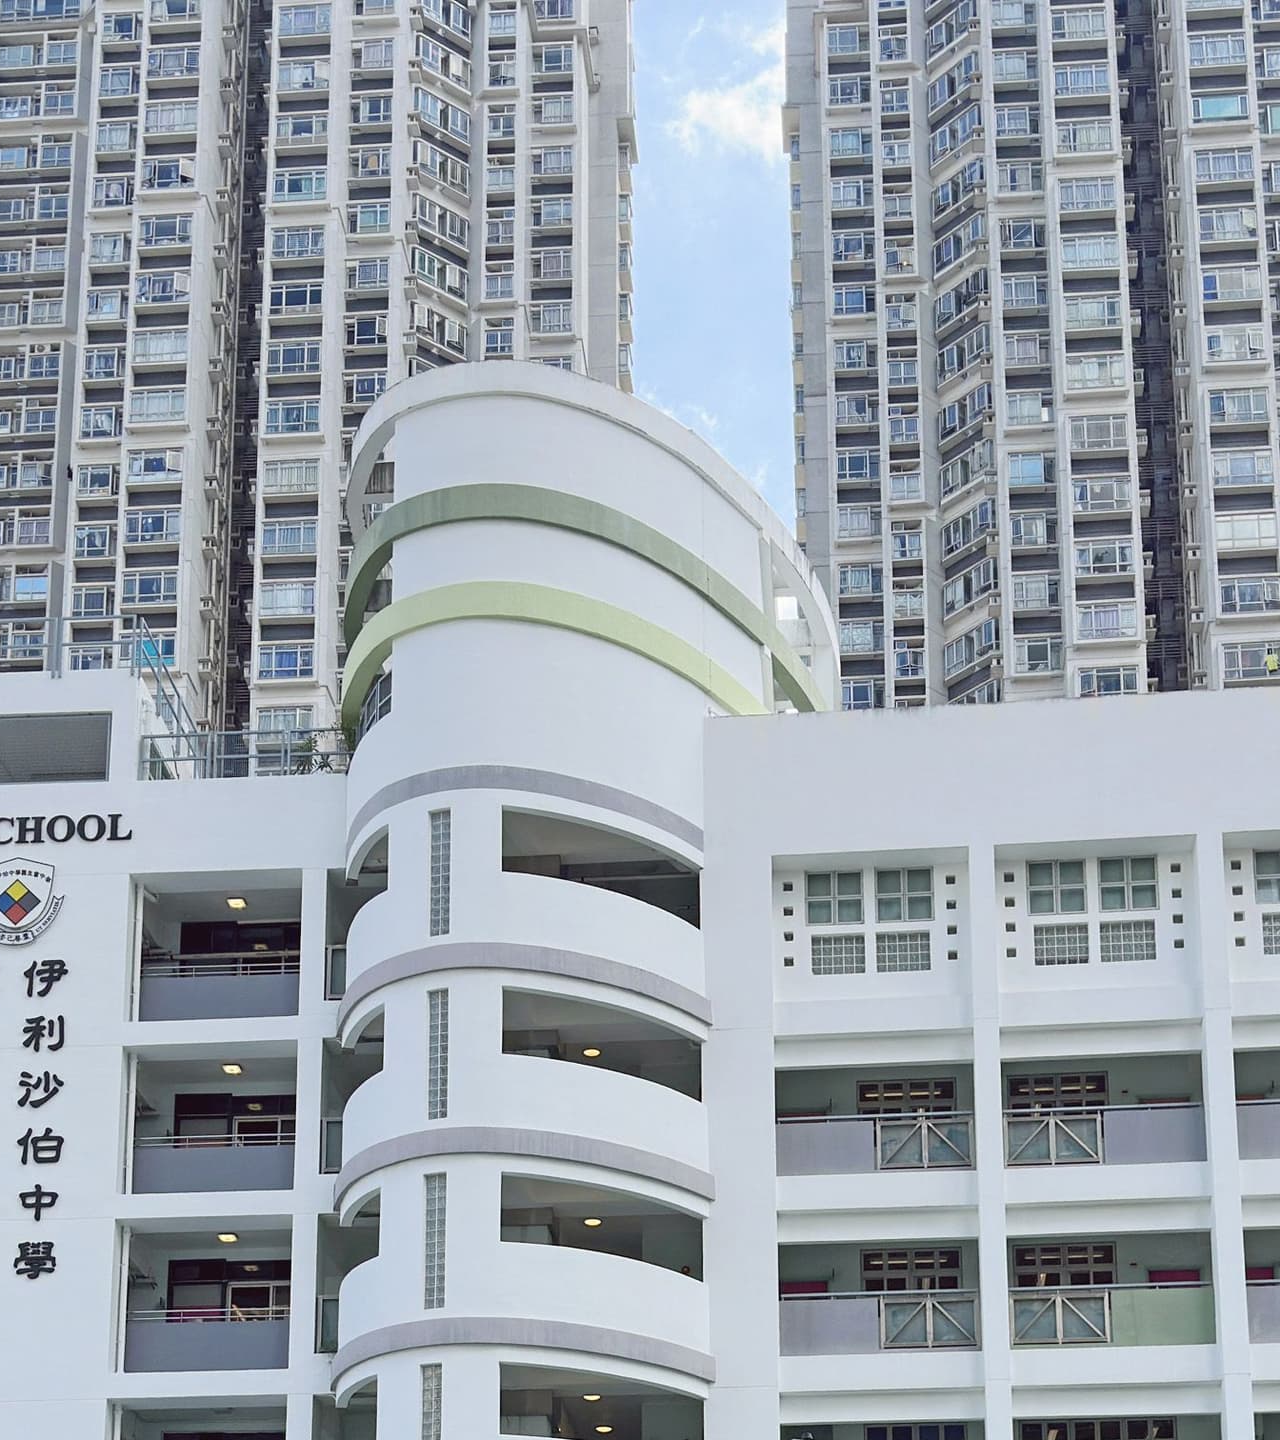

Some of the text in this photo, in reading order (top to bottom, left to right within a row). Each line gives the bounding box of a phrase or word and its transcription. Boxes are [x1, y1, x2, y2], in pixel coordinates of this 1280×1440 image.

[13, 959, 68, 1279] 伊利沙伯中學
